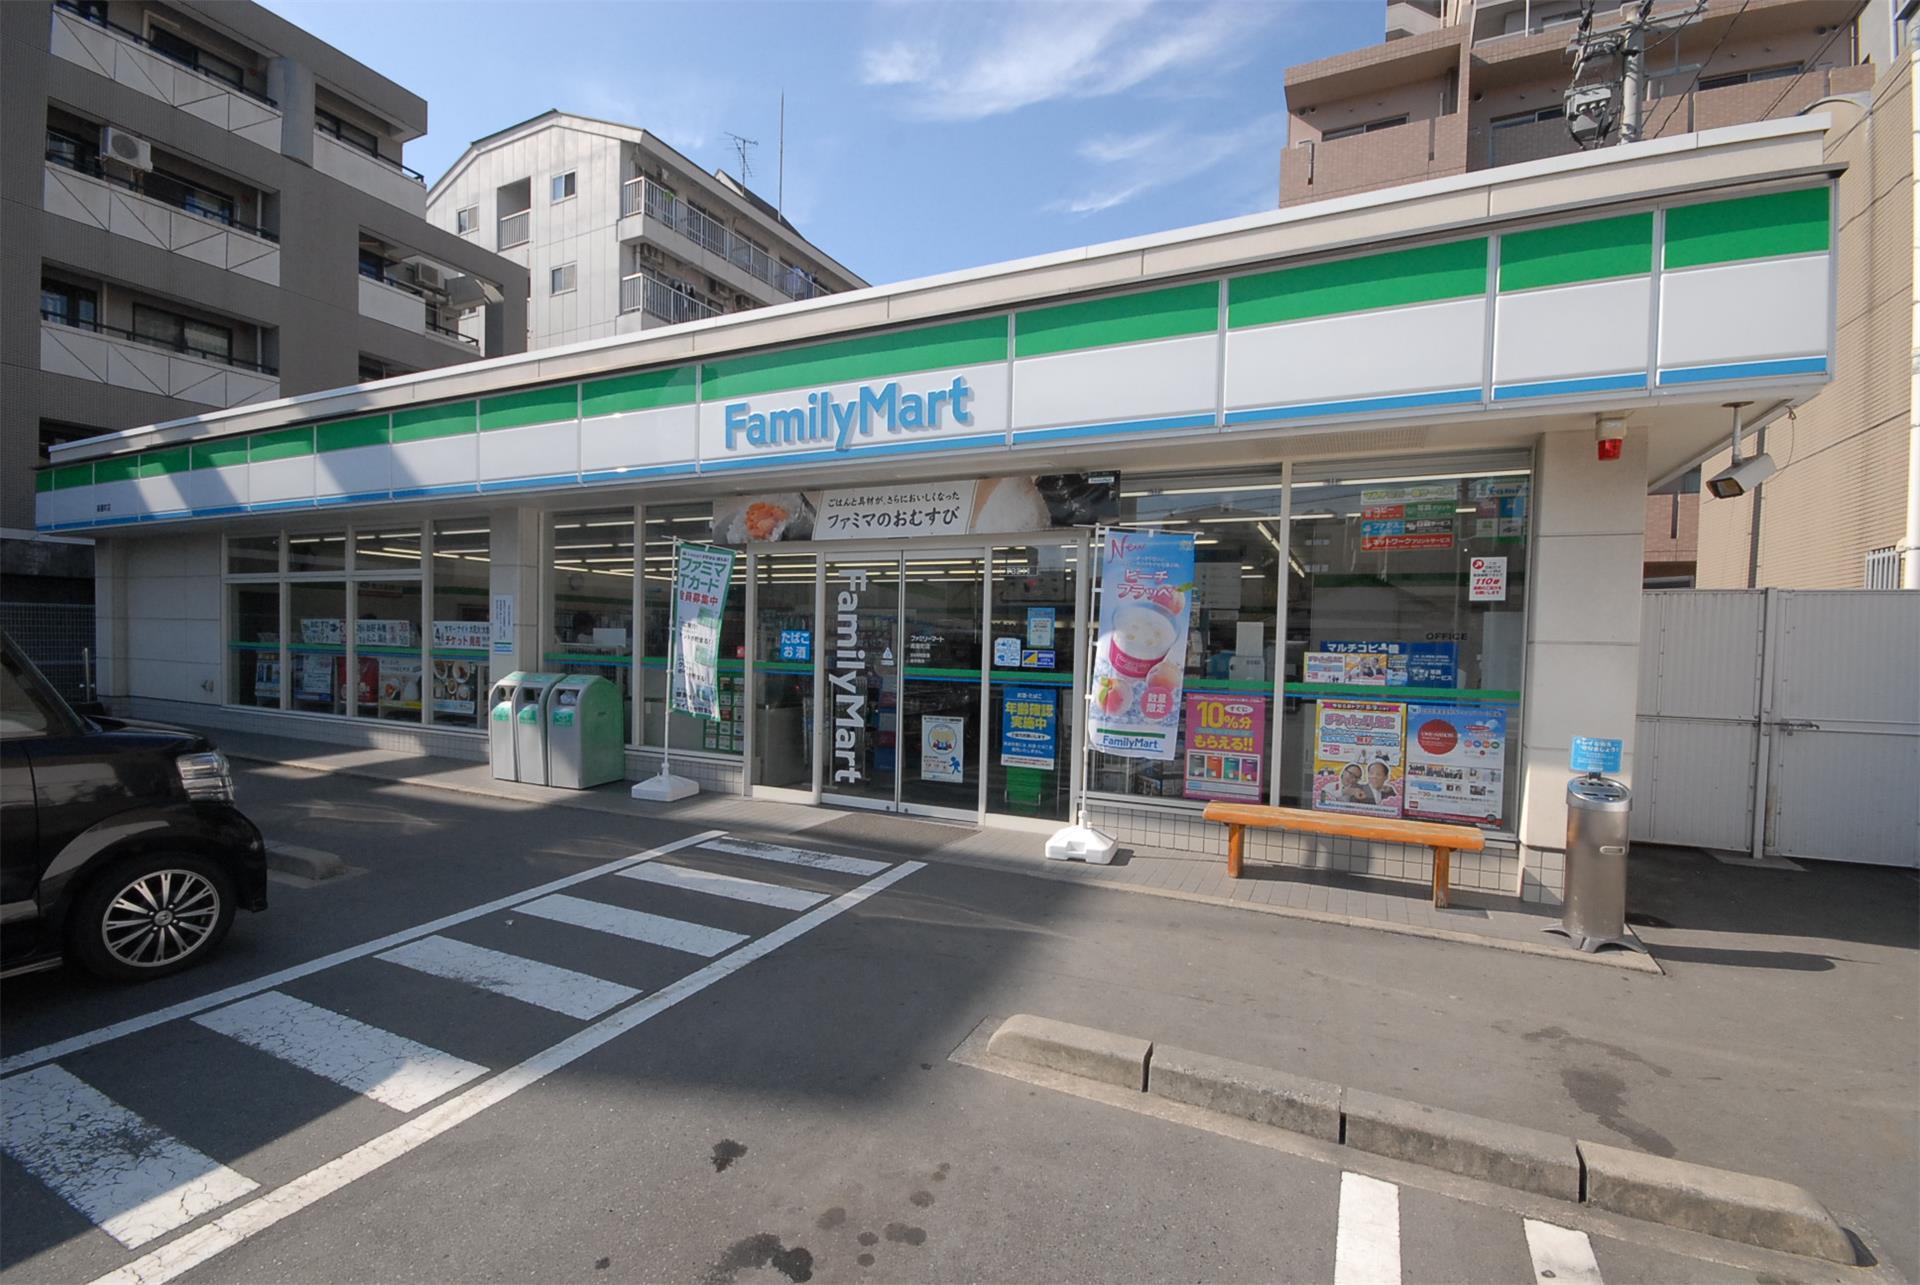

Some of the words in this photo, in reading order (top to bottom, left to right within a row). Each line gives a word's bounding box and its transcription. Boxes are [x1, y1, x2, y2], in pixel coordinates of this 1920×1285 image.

[725, 375, 974, 451] FamilyMart
[827, 506, 960, 530] ファミマのおむすび
[1107, 534, 1147, 564] New
[680, 556, 727, 577] ファミマ
[680, 573, 719, 593] Tカード
[1124, 568, 1169, 585] ピーチ
[1117, 583, 1176, 600] フラッペ
[780, 631, 810, 644] たばこ
[1426, 632, 1467, 641] OFFICE
[783, 645, 807, 659] お酒
[1327, 643, 1400, 654] マルチコピー機
[828, 569, 867, 784] FamilyMart
[1146, 703, 1167, 714] 限定
[1103, 734, 1158, 750] FamilyMart
[1194, 735, 1254, 752] もらえる!!
